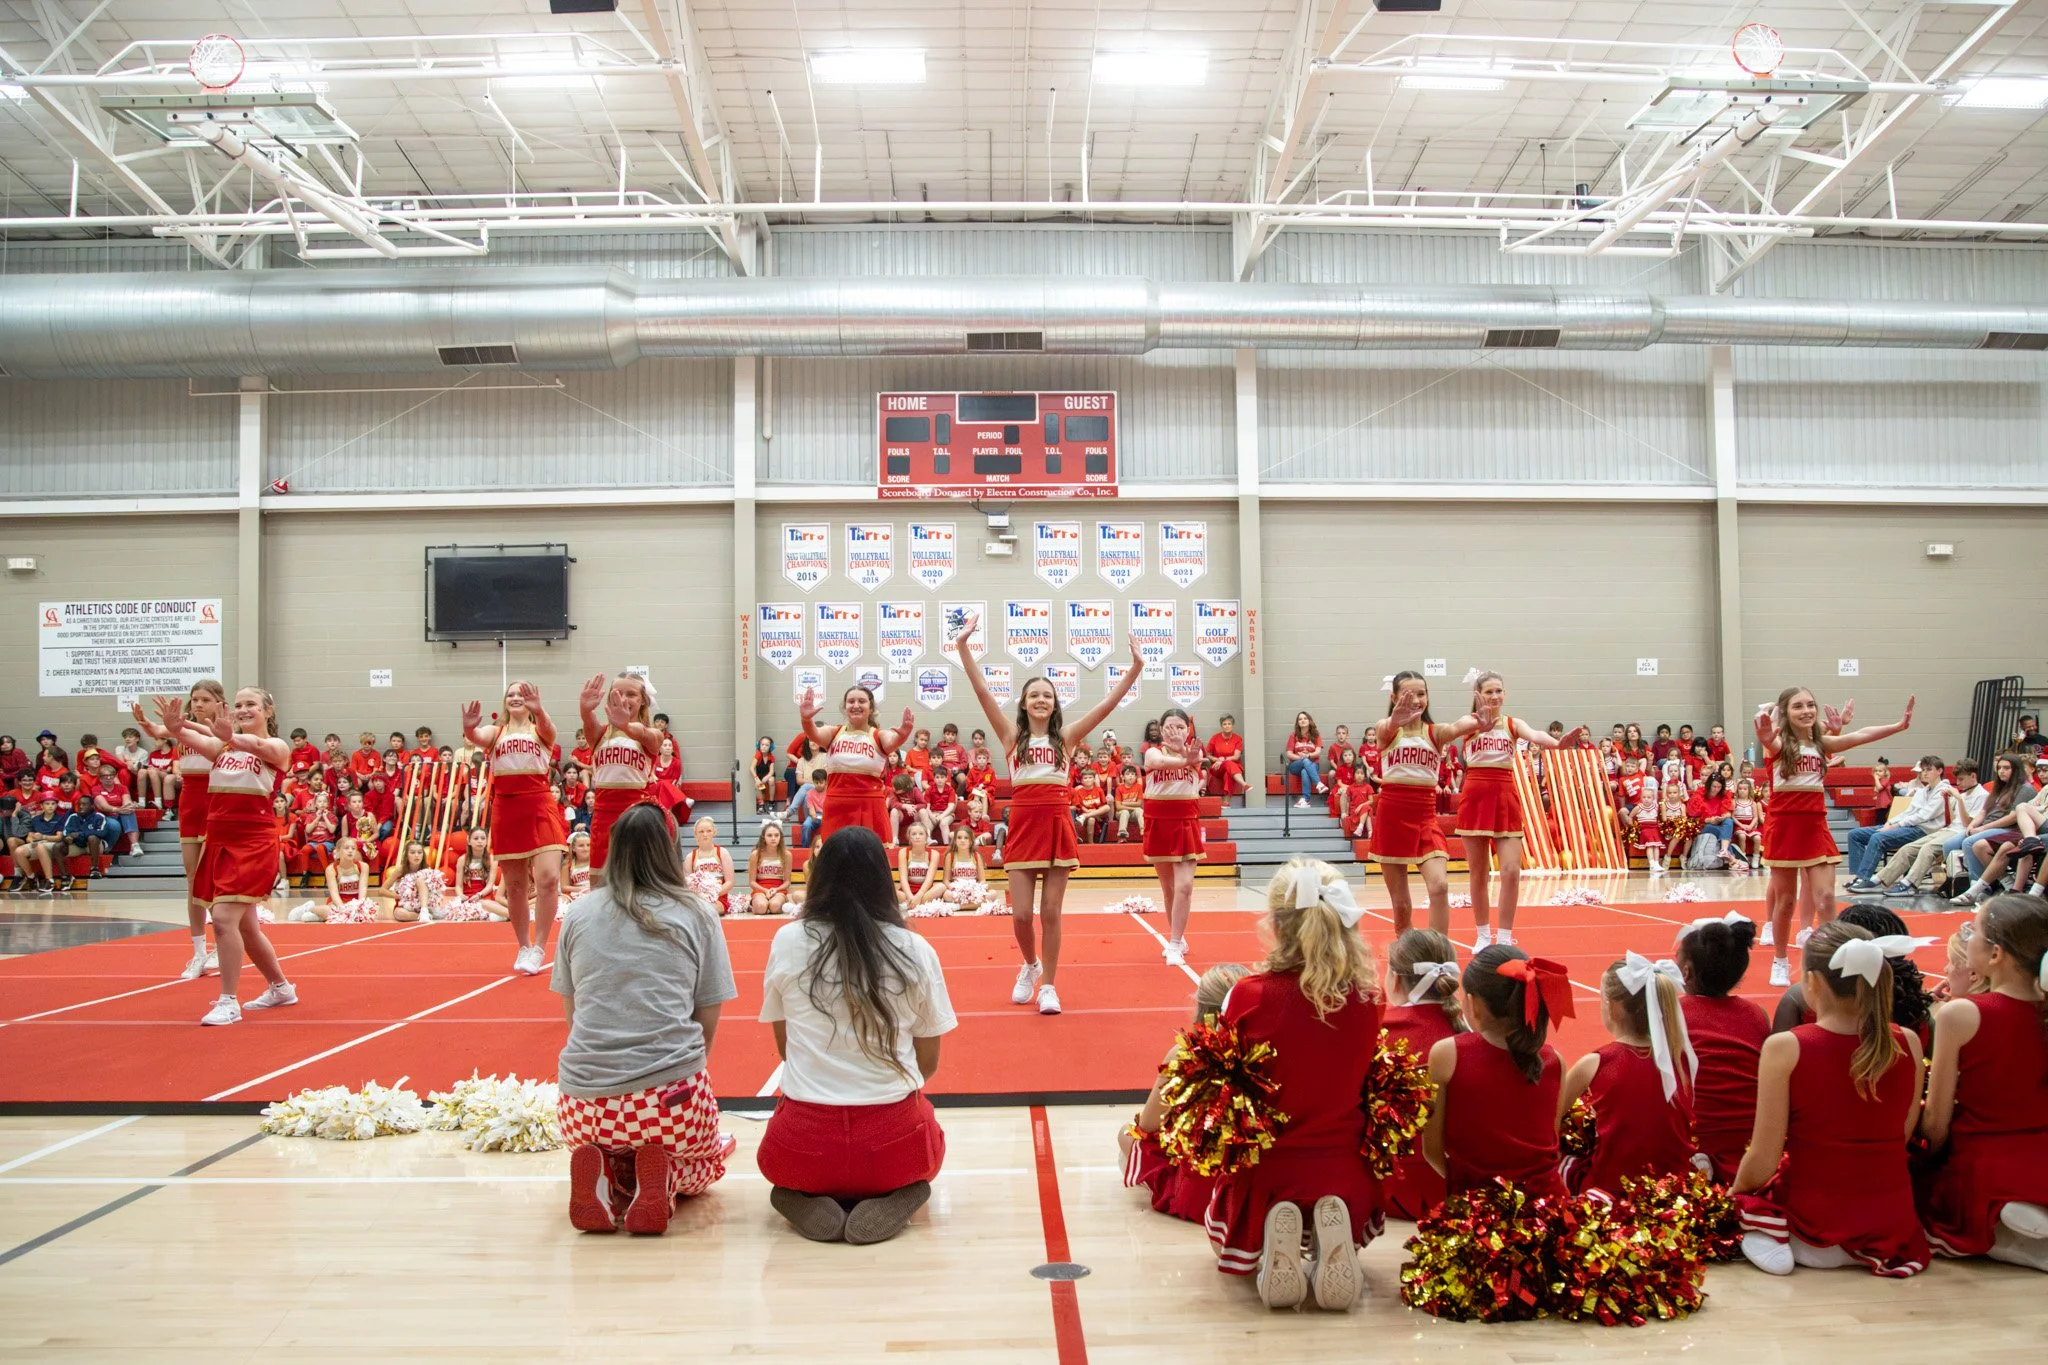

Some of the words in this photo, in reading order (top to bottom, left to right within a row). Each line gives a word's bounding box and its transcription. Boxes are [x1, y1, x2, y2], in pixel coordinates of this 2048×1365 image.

[888, 397, 927, 410] HOME
[1064, 396, 1108, 409] GUEST
[882, 488, 931, 497] Scoreboard
[934, 488, 971, 496] Donated
[973, 488, 984, 498] by
[1018, 488, 1074, 496] Construction
[850, 552, 890, 560] VOLLEYBALL
[912, 552, 952, 560] VOLLEYBALL
[1100, 551, 1140, 559] BASKETBALL
[786, 560, 828, 569] CHAMPIONS
[850, 560, 890, 569] CHAMPION
[912, 559, 952, 569] CHAMPION
[1038, 558, 1078, 568] CHAMPION
[1101, 559, 1140, 568] RUNNERUP
[797, 572, 817, 581] 2018
[65, 604, 112, 615] ATHLETICS
[115, 603, 138, 614] CODE
[141, 602, 153, 614] OF
[155, 602, 196, 613] CONDUCT
[761, 632, 801, 640] VOLLEYBALL
[881, 630, 921, 638] BASKETBALL
[1070, 628, 1110, 637] VOLLEYBALL
[761, 640, 801, 649] CHAMPION
[819, 640, 859, 648] CHAMPIONS
[881, 638, 922, 647] CHAMPIONS
[1008, 637, 1048, 645] CHAMPION
[1070, 637, 1110, 646] CHAMPION
[1136, 637, 1172, 645] HAMPION
[1197, 637, 1237, 645] CHAMPION
[1247, 610, 1256, 675] WARRIORS
[740, 614, 750, 680] WARRIORS
[944, 643, 983, 652] CHAION
[495, 739, 541, 758] WARRIORS
[830, 740, 874, 759] WARRIORS
[1471, 738, 1513, 753] WARRIORS
[595, 747, 645, 771] WARRIORS
[1388, 747, 1438, 770] WARRIORS
[1153, 769, 1194, 784] WARRIORS
